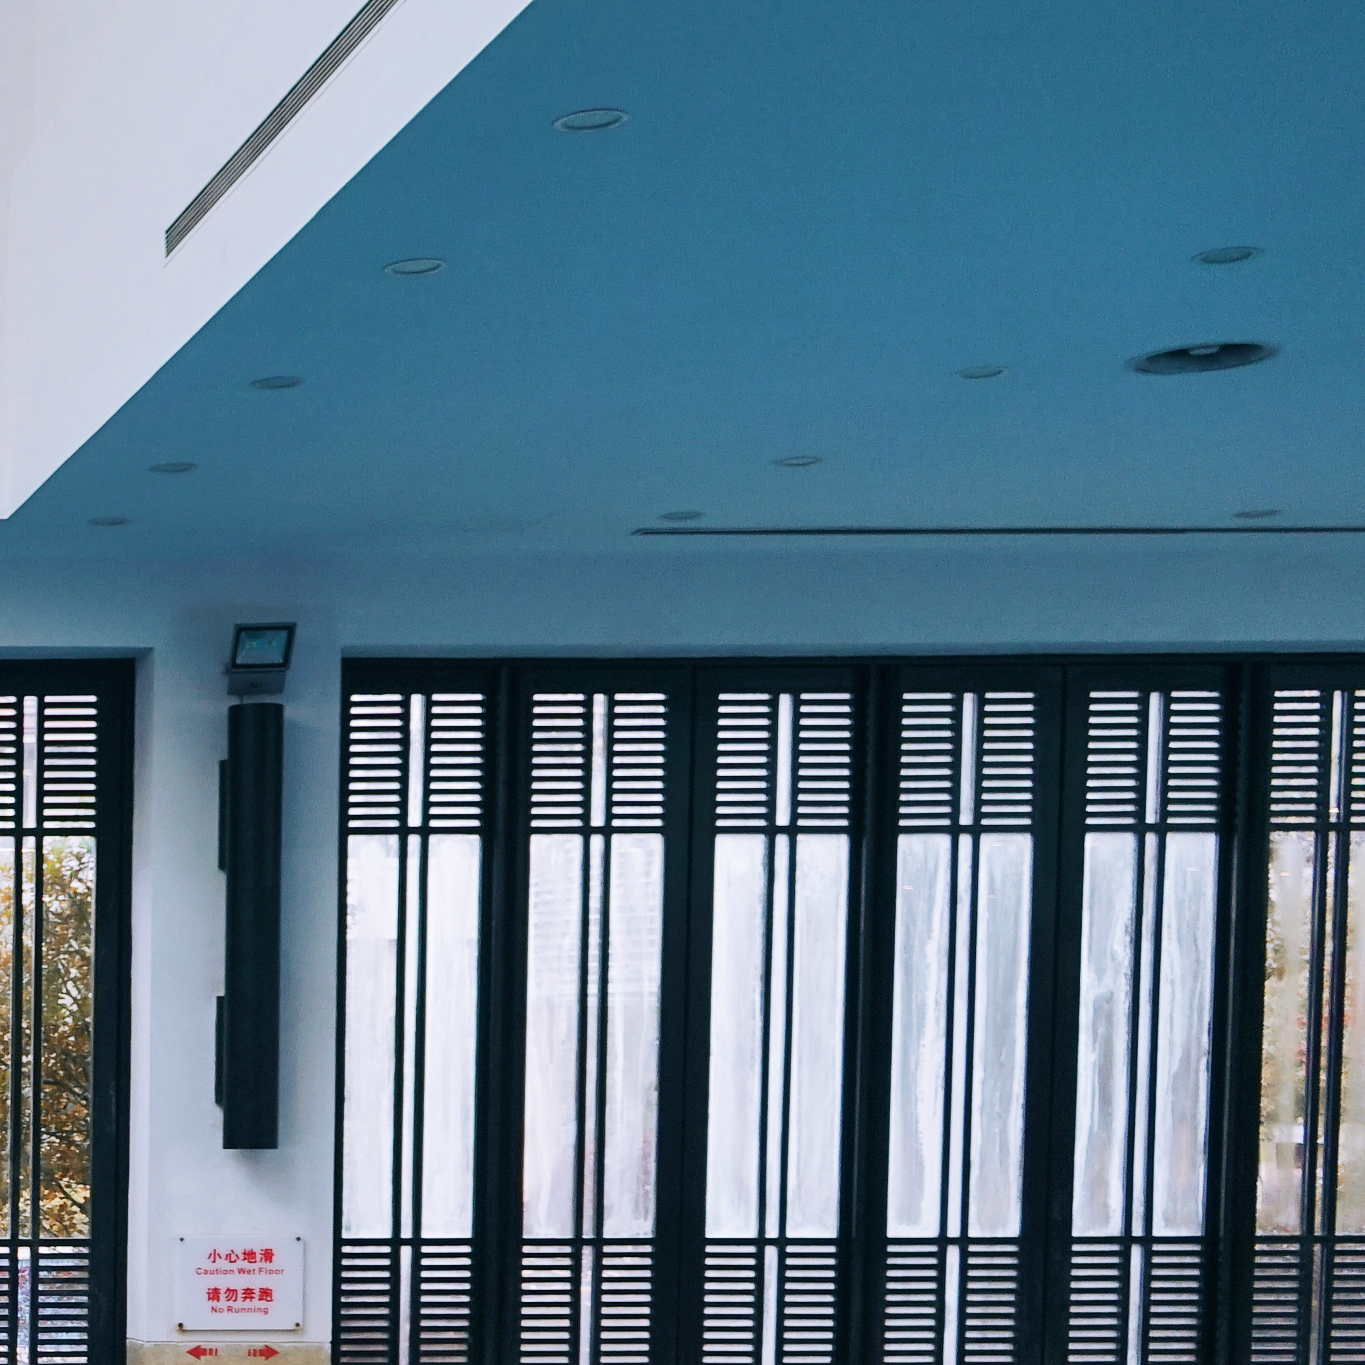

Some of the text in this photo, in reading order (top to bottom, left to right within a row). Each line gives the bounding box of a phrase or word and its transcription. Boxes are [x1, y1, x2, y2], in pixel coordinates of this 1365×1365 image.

[207, 1249, 274, 1263] 小心地滑
[195, 1267, 285, 1275] Caution Wet Floor
[206, 1287, 274, 1302] 请勿奔跑
[226, 1306, 269, 1315] Running
